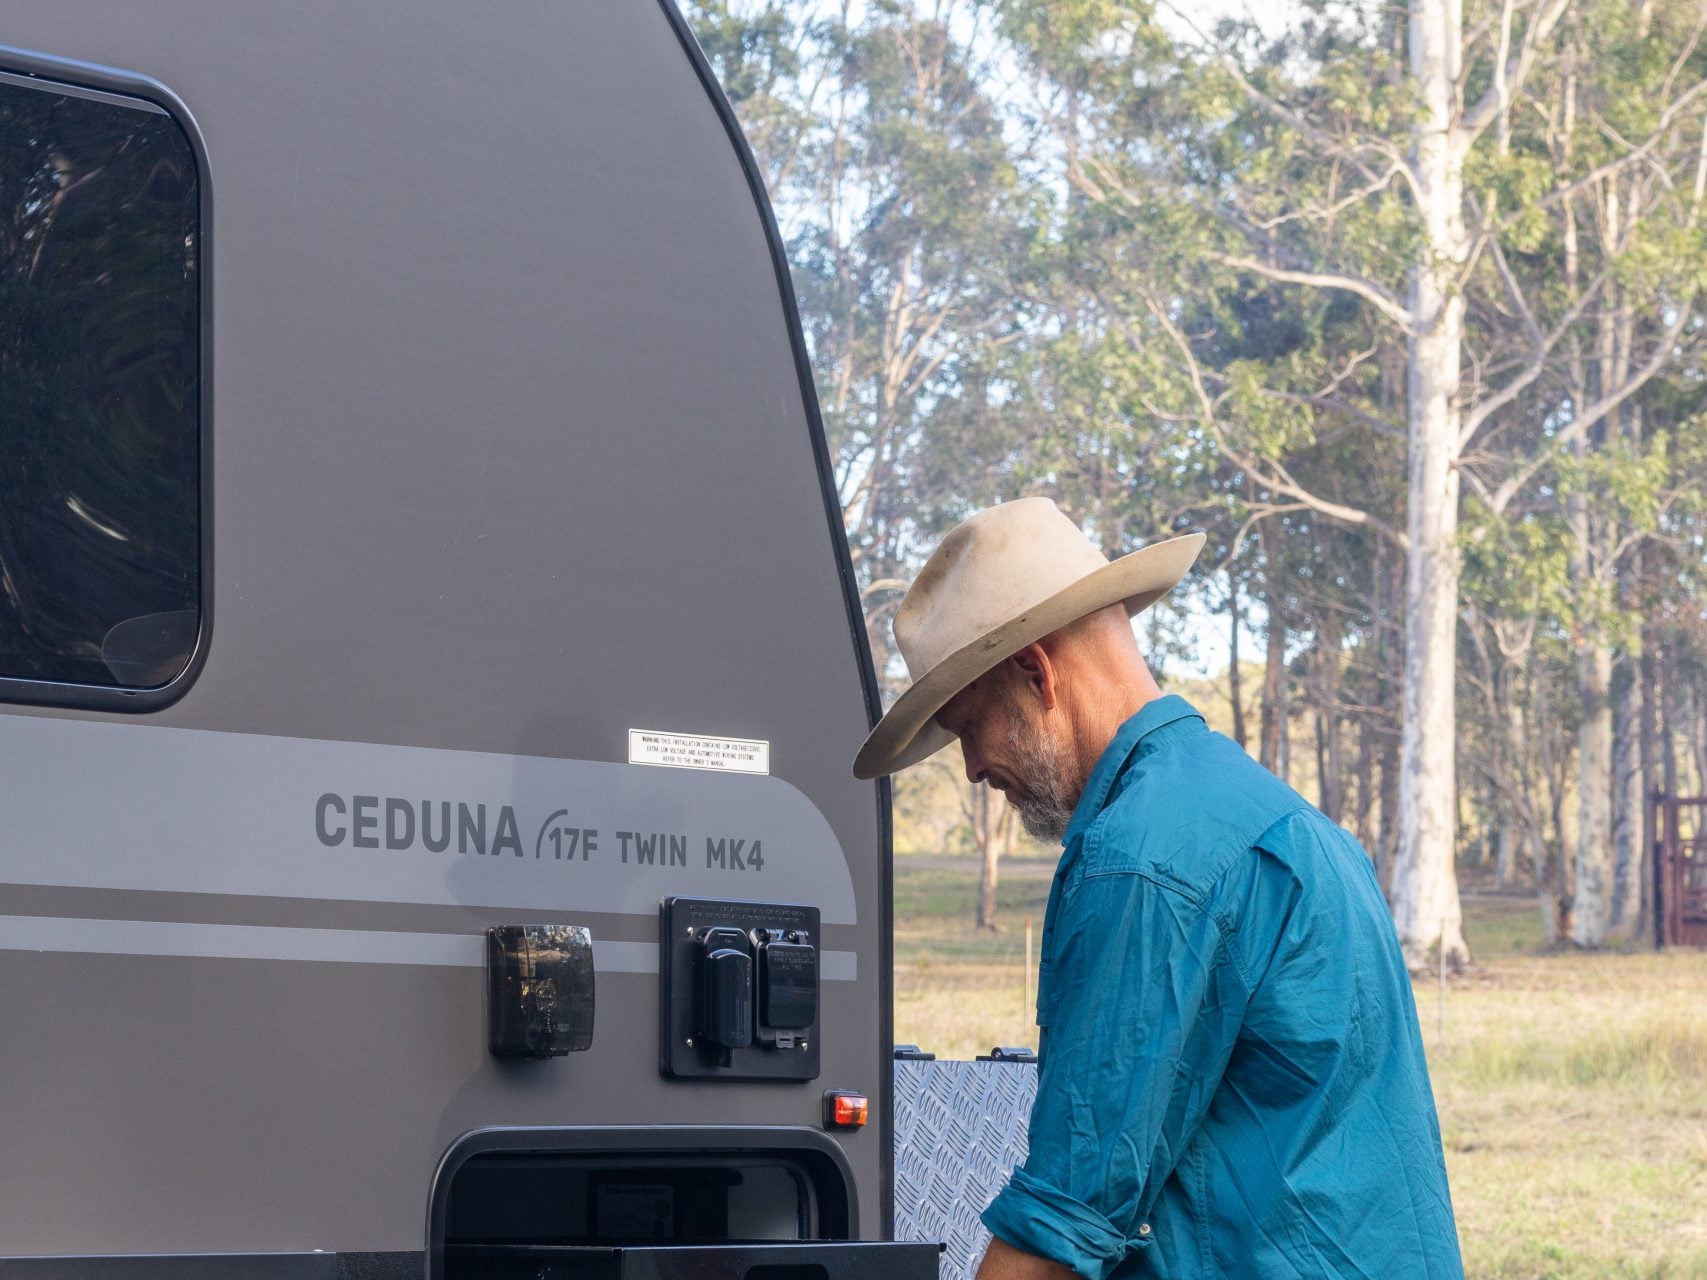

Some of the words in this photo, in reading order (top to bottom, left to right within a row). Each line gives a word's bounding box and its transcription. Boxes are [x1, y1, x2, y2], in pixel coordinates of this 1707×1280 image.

[672, 739, 701, 747] INSTALLATION
[670, 747, 686, 755] VOLTAGE
[697, 749, 721, 758] AUTOMOTIVE
[722, 752, 736, 760] WIRING
[315, 792, 524, 858] CEDUNA
[548, 827, 599, 861] 17F
[615, 831, 687, 867] TWIN
[706, 837, 765, 872] MK4
